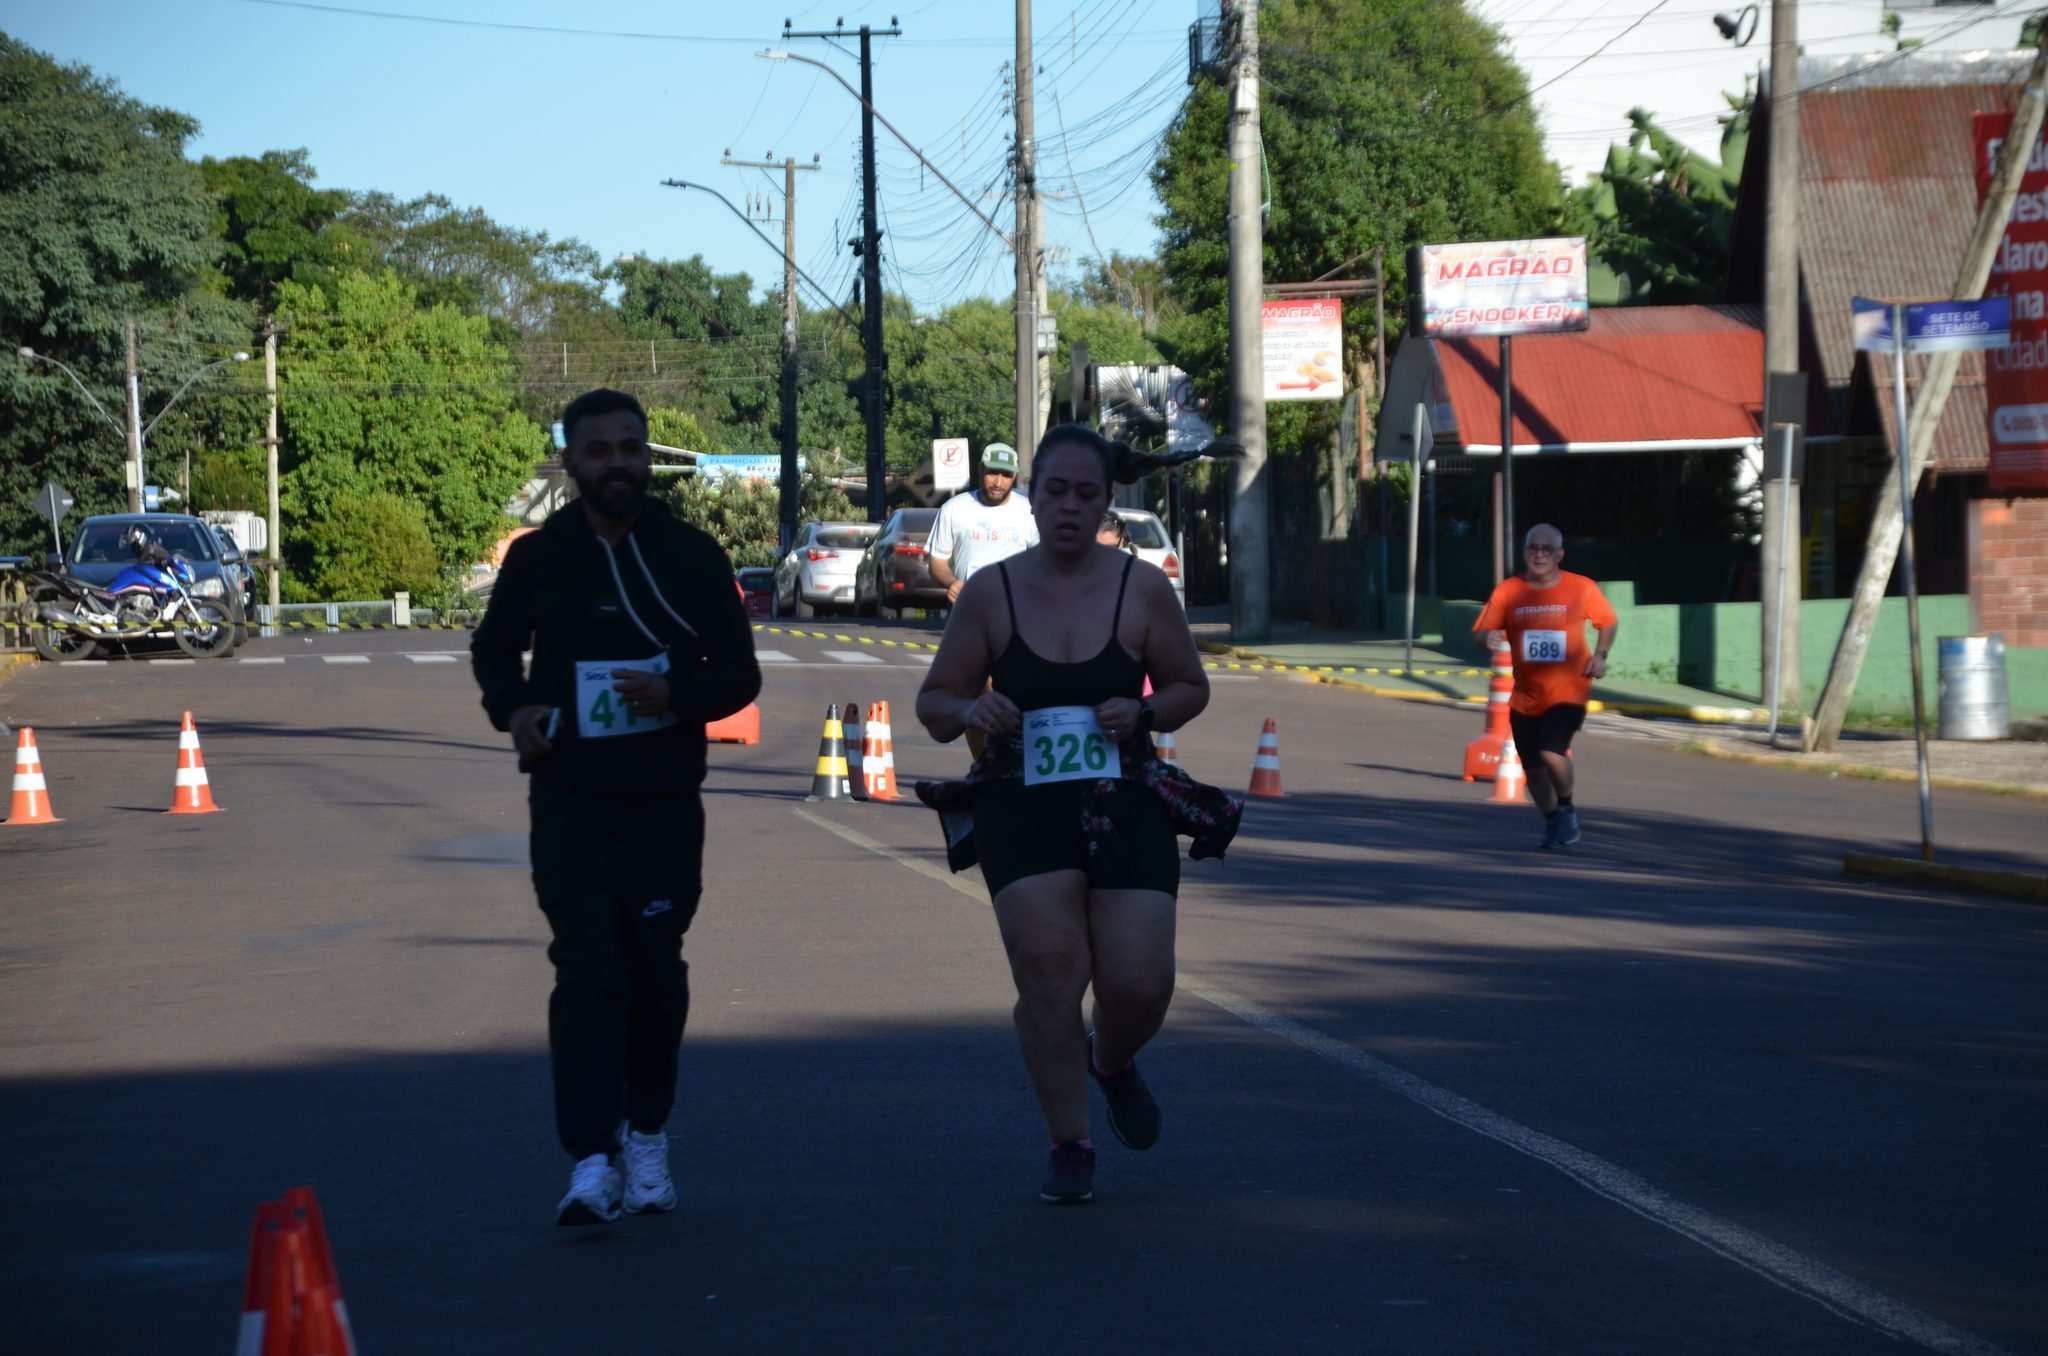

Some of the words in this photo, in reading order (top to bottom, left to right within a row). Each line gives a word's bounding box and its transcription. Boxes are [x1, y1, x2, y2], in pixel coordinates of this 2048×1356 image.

[1439, 250, 1574, 281] MAGRÃO
[1263, 303, 1336, 320] MAGRÃO
[1453, 304, 1562, 324] SNOOKER
[1930, 312, 1961, 323] SETE
[1964, 311, 1981, 321] DE
[1922, 321, 1990, 335] SETEMBRO
[1529, 641, 1560, 658] 689
[1034, 732, 1107, 776] 326
